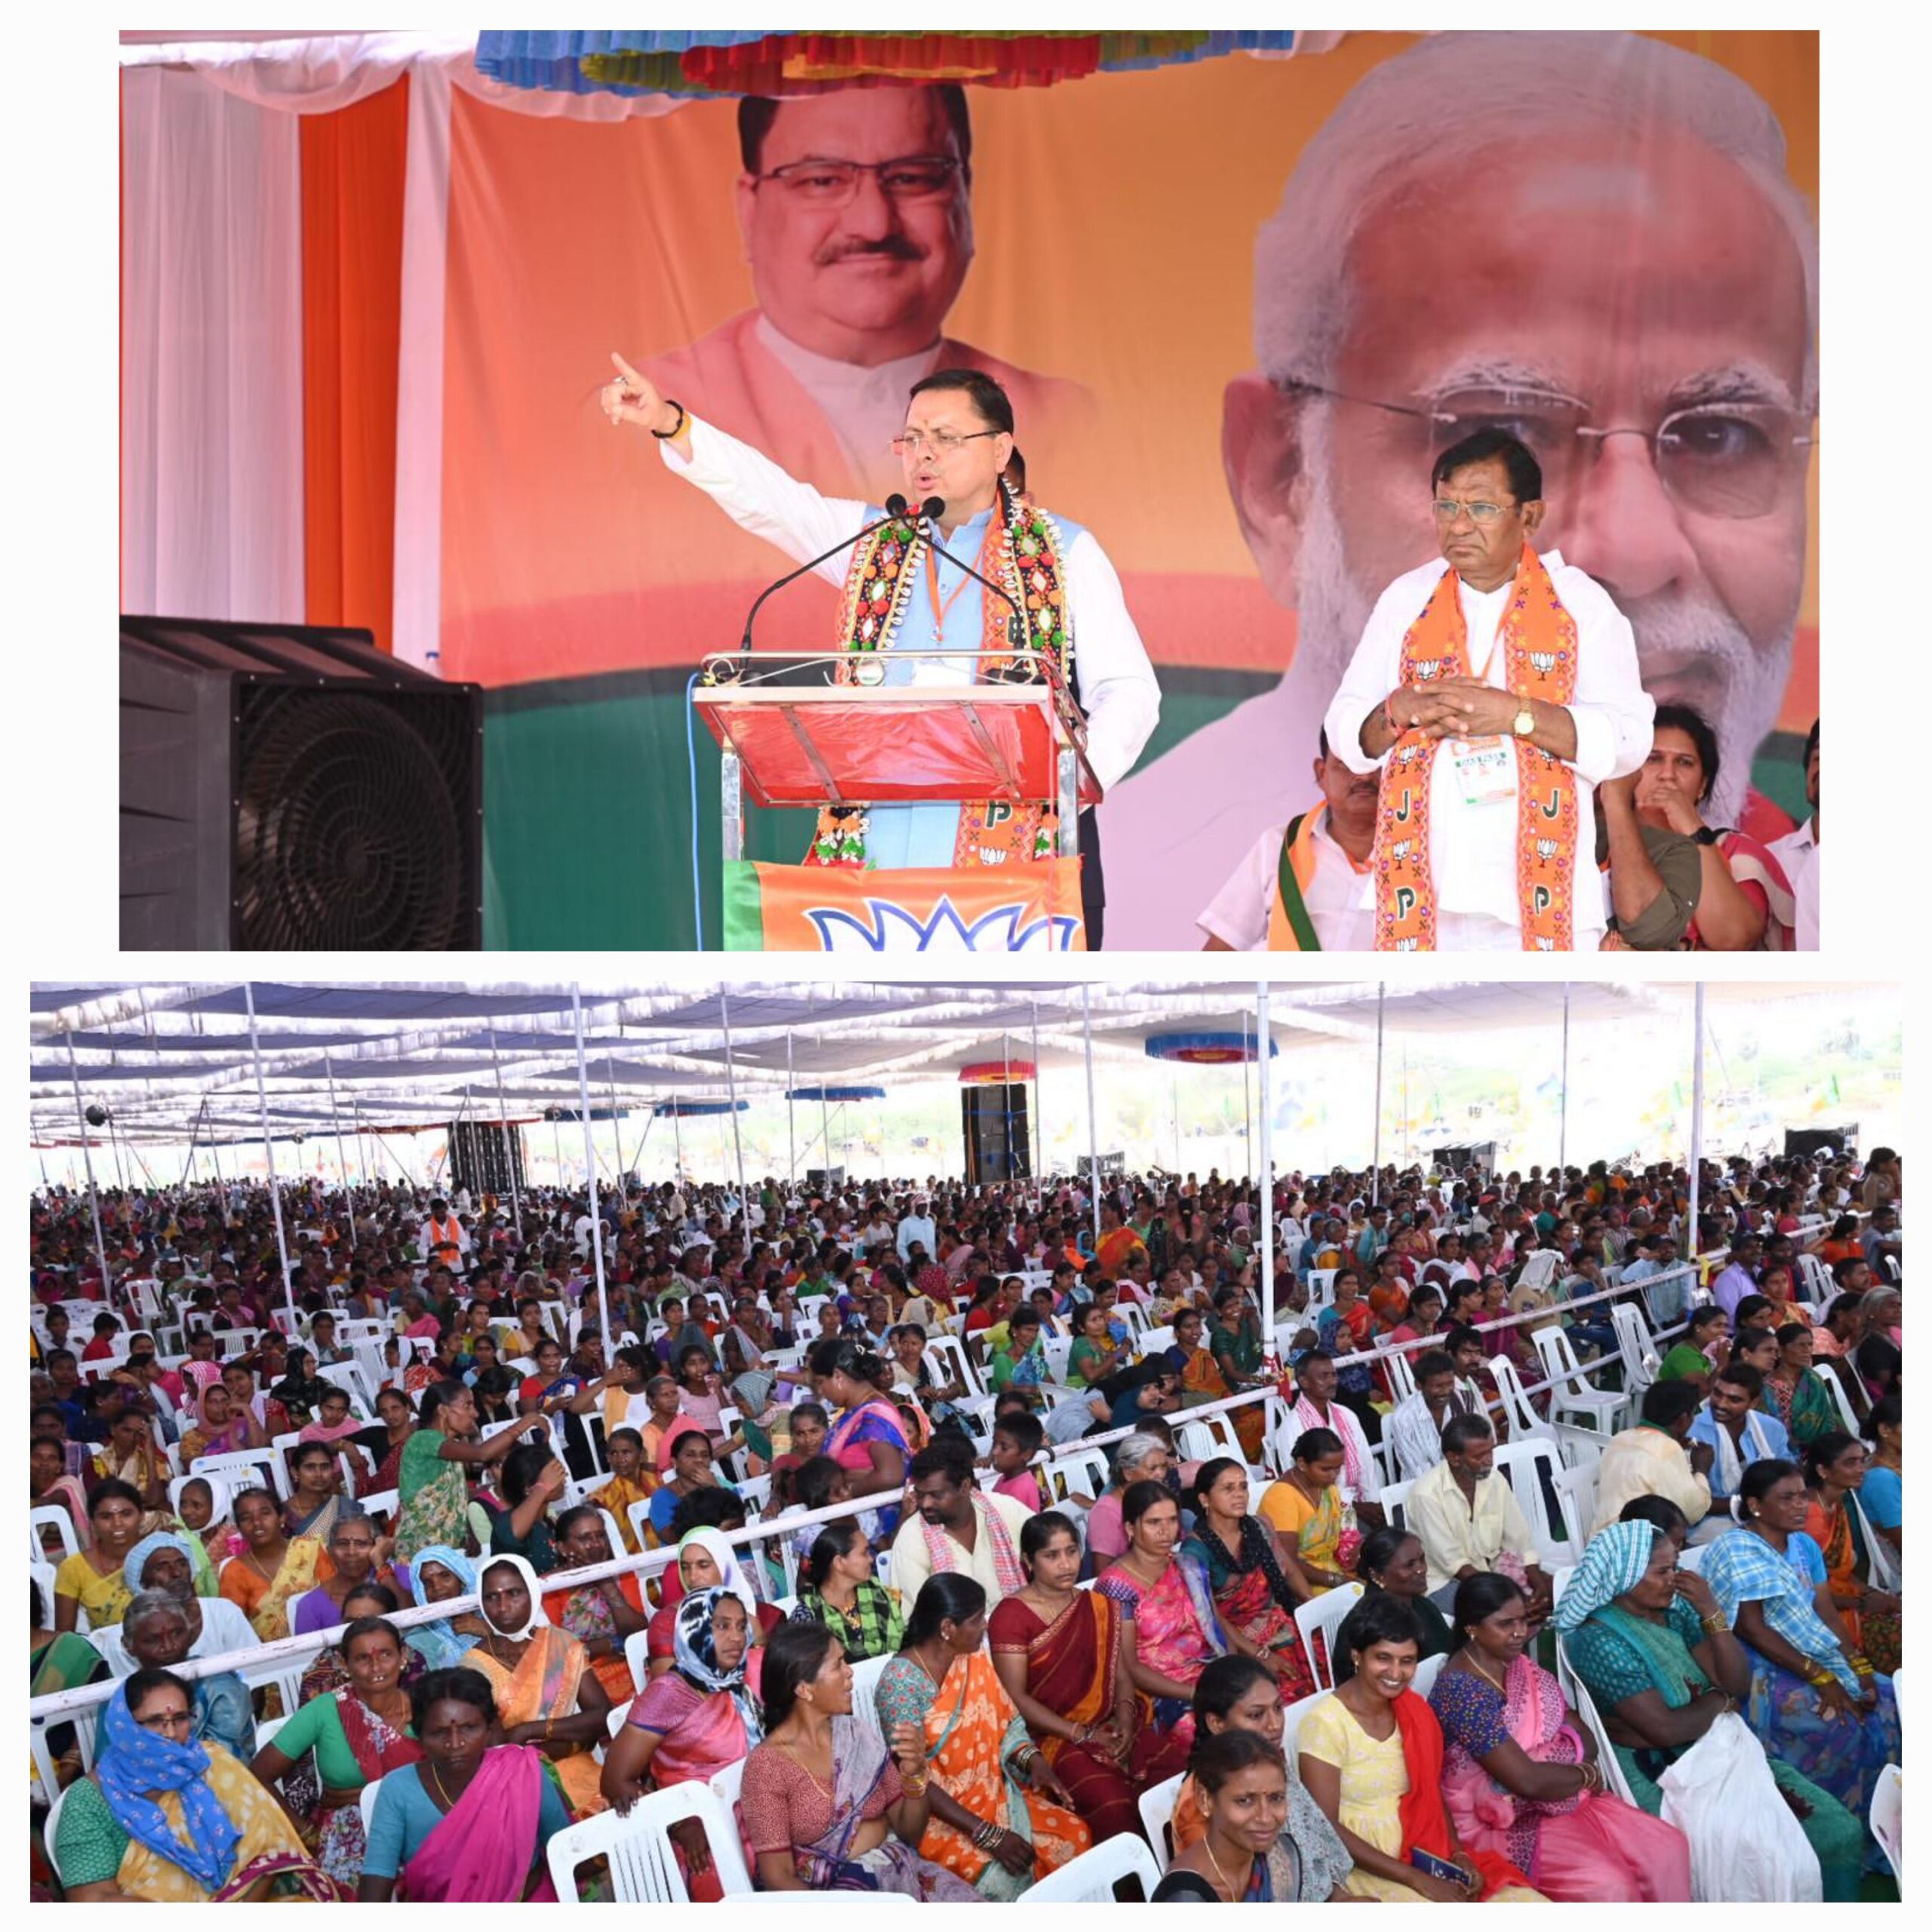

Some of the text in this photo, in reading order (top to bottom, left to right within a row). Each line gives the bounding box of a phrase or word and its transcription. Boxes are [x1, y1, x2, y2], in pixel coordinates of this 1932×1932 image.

[985, 800, 1012, 829] P
[1396, 789, 1410, 821] J
[1542, 789, 1559, 820] J
[1395, 887, 1417, 920] P
[1535, 885, 1551, 915] P
